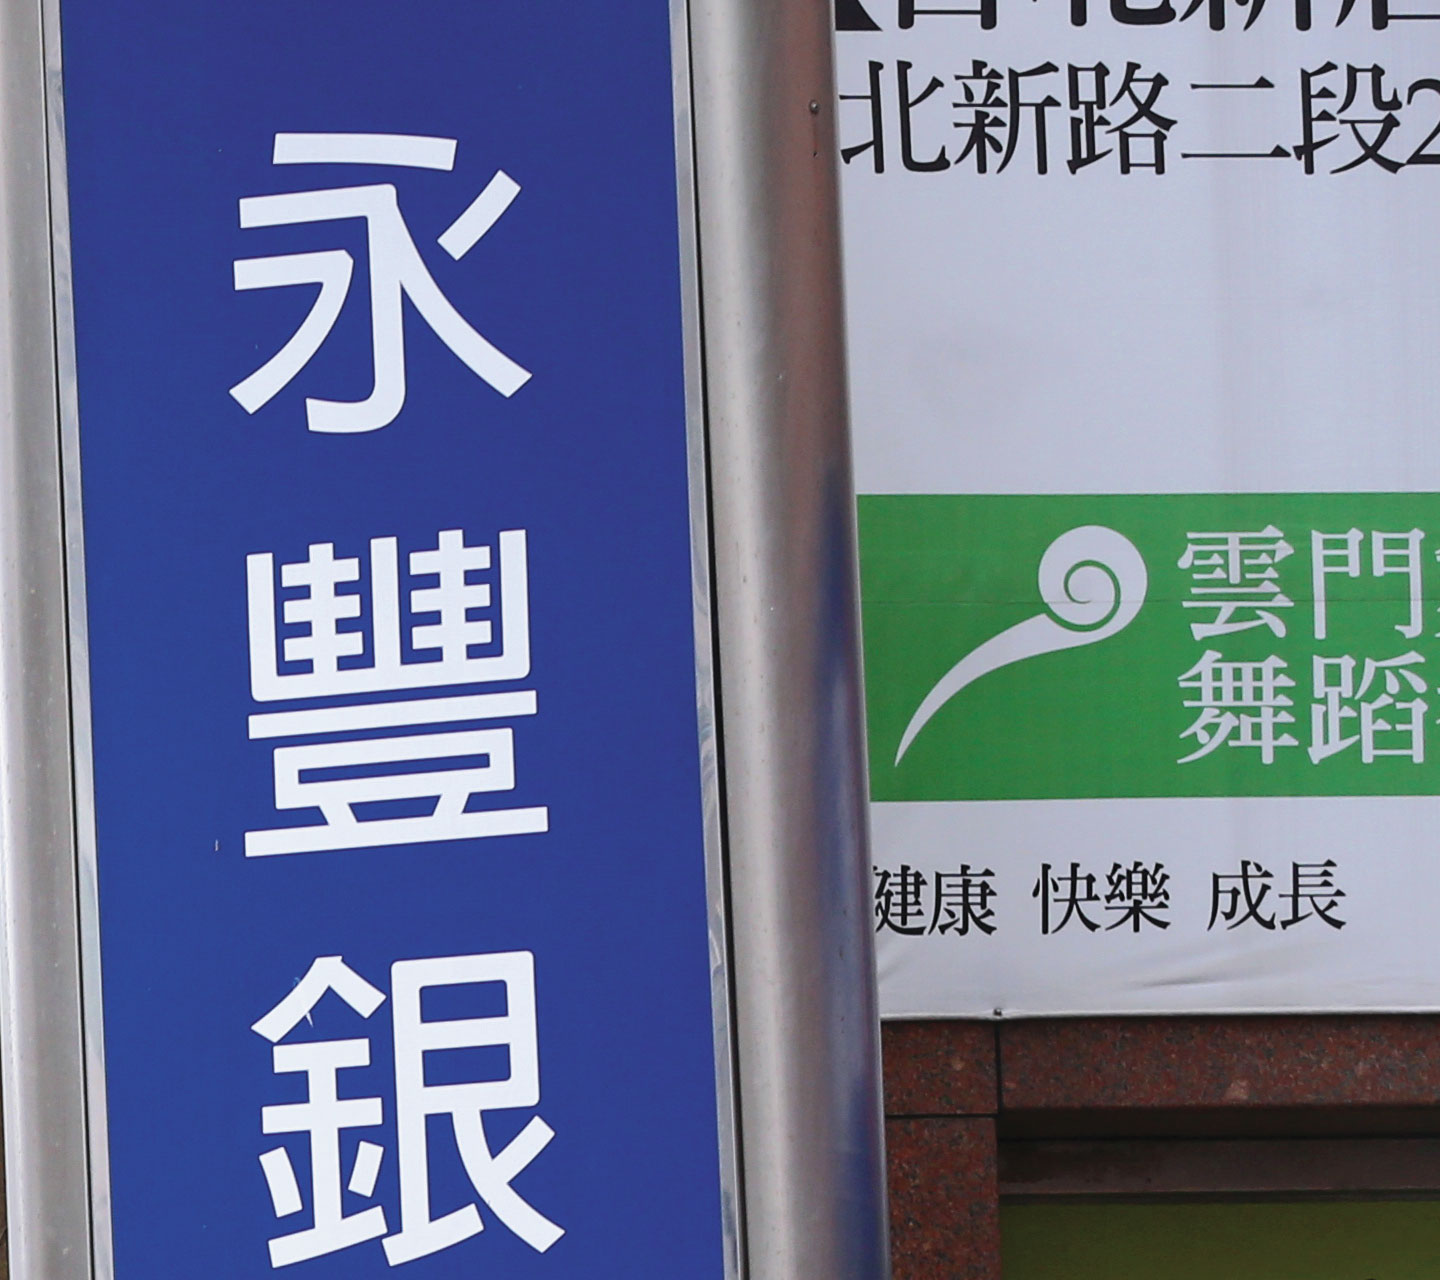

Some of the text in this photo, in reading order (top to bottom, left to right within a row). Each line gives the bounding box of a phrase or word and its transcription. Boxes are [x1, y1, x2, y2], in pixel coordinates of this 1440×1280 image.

[1178, 525, 1440, 641] 雲門
[1177, 650, 1440, 766] 舞蹈
[1033, 861, 1171, 934] 快樂
[1206, 859, 1347, 932] 成長
